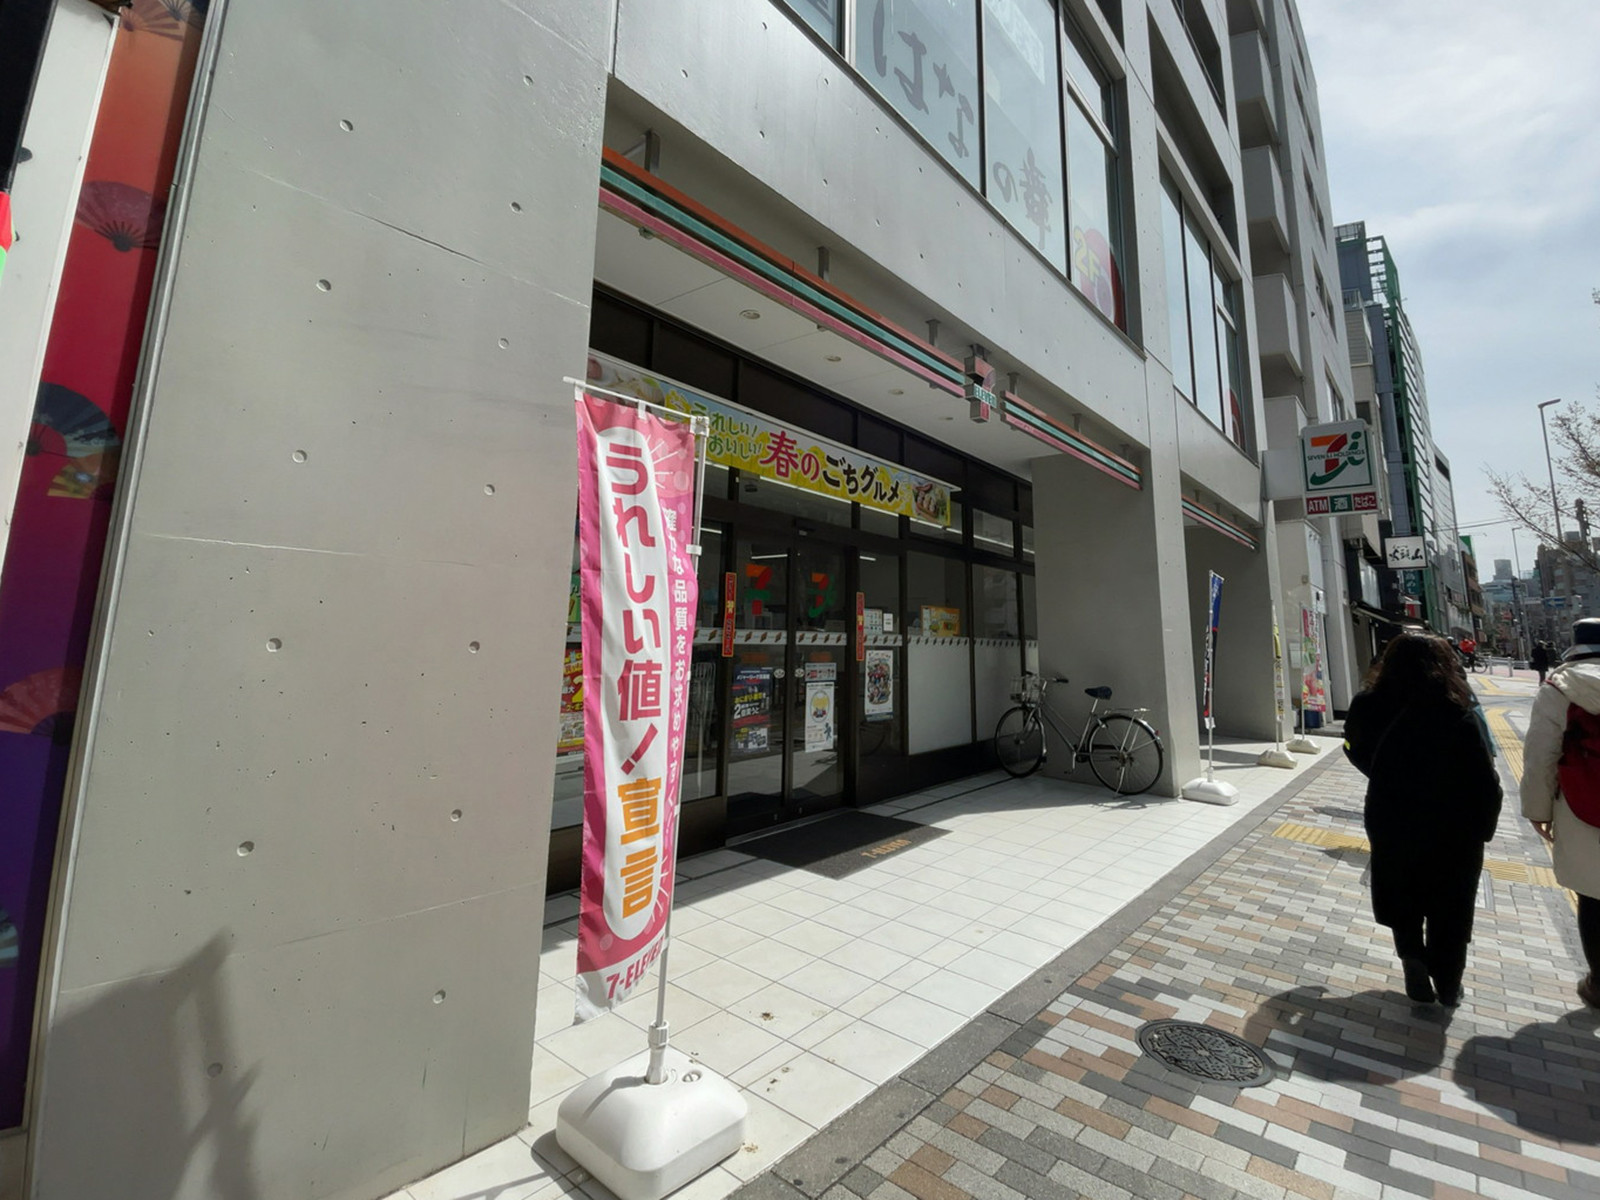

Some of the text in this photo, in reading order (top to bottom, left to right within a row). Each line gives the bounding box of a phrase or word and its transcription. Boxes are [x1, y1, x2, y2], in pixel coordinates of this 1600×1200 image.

[1308, 499, 1329, 512] ATM
[1334, 497, 1348, 509] 酒
[1354, 495, 1376, 508] たばこ
